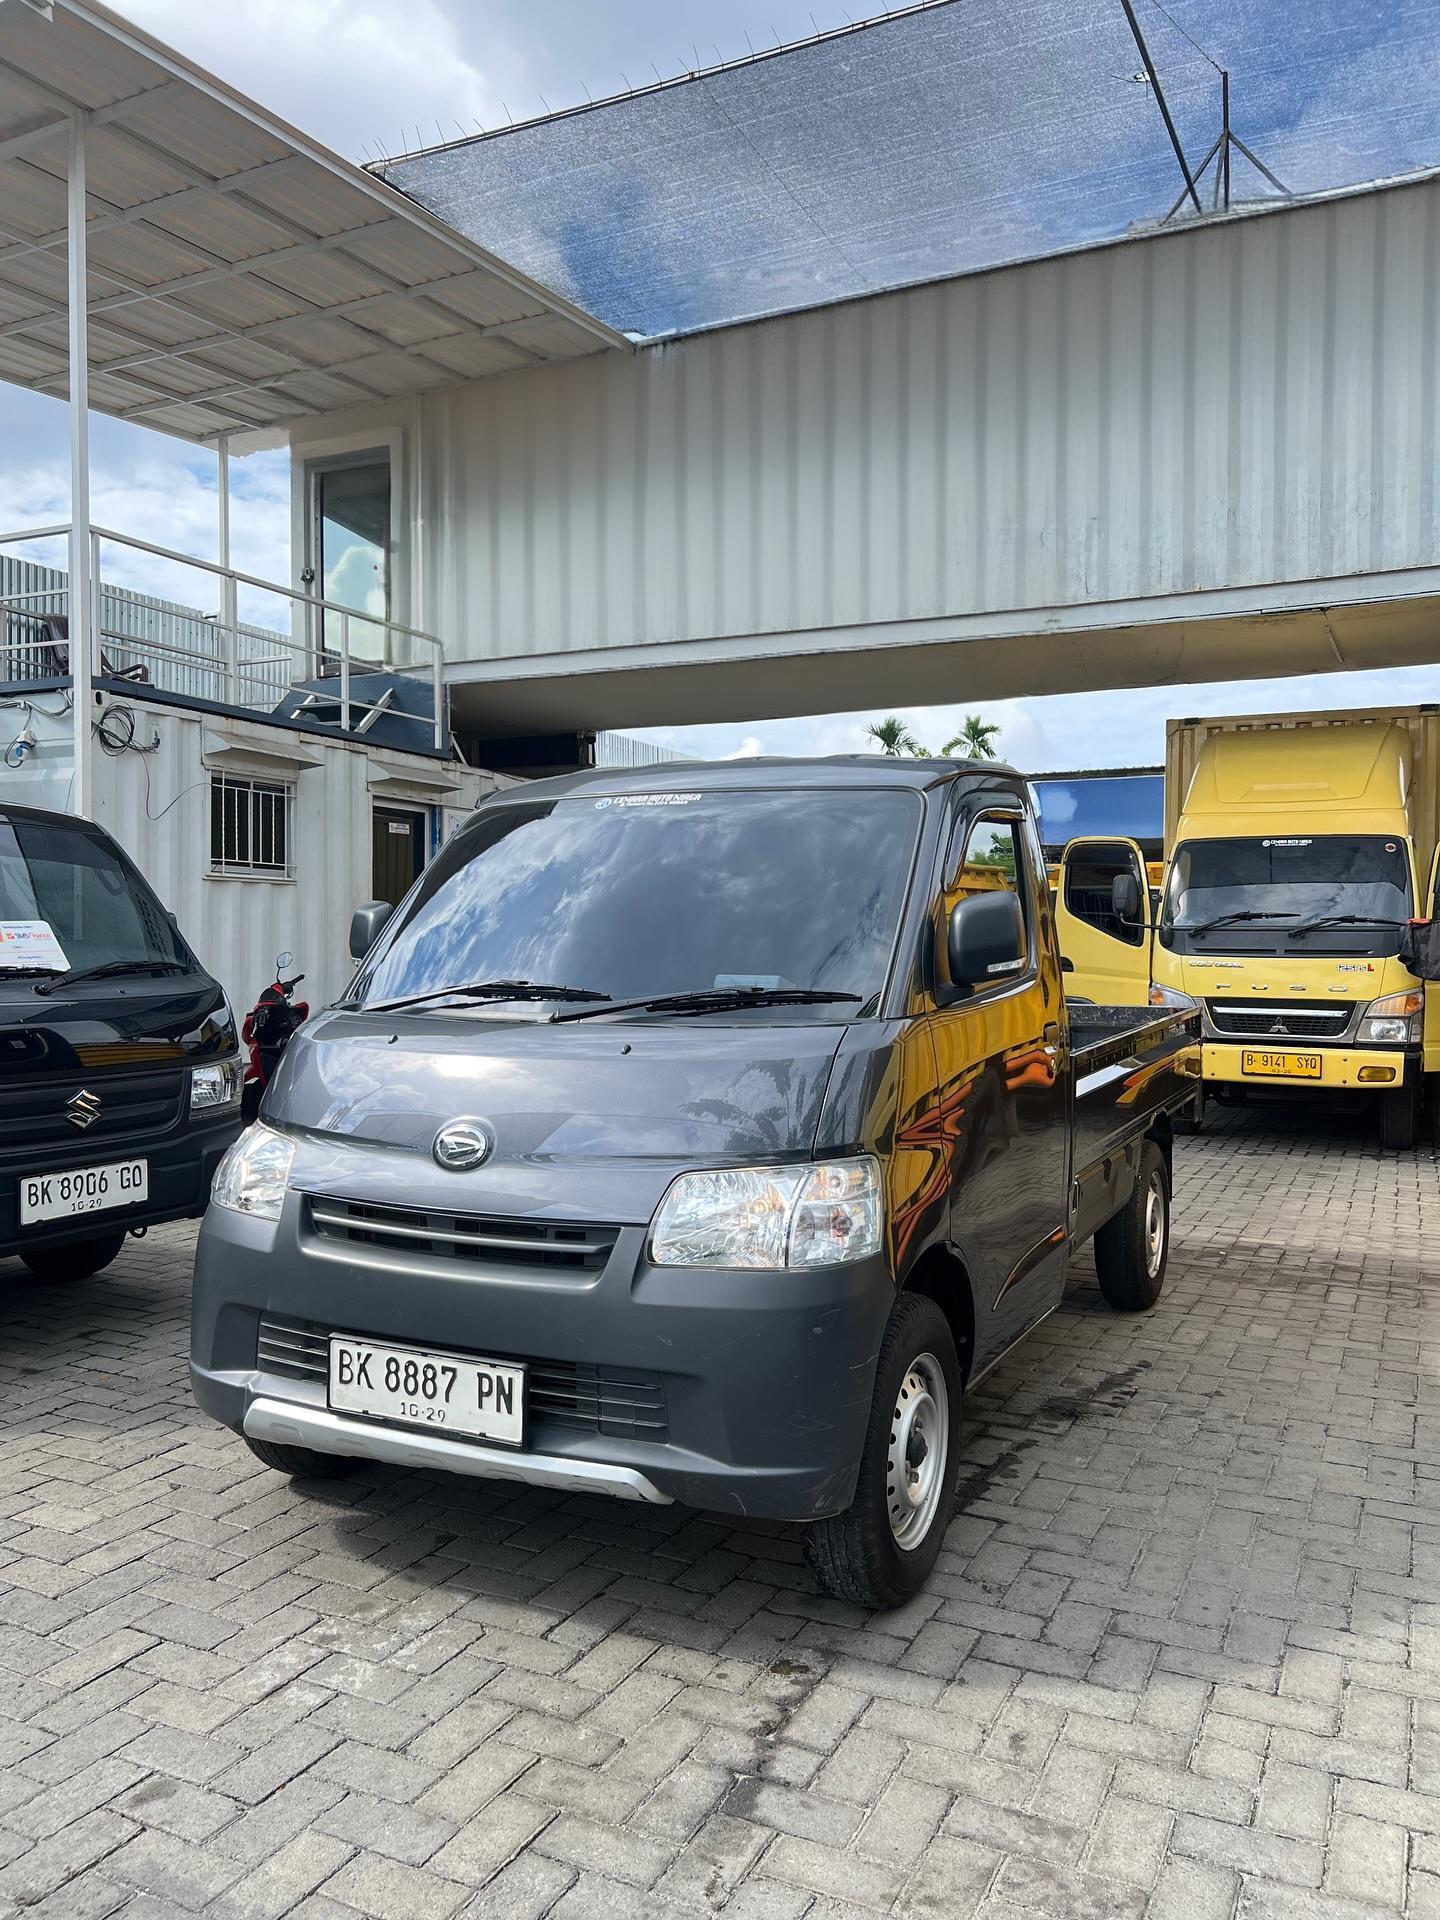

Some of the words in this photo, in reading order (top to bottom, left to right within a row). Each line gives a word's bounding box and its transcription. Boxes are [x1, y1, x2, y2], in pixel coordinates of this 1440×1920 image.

[1246, 1053, 1254, 1066] B
[1262, 1054, 1286, 1068] 9141
[28, 1179, 53, 1208] BK
[60, 1170, 109, 1201] 8906
[338, 1348, 375, 1390] BK
[384, 1356, 458, 1404] 8887
[476, 1371, 514, 1415] PN
